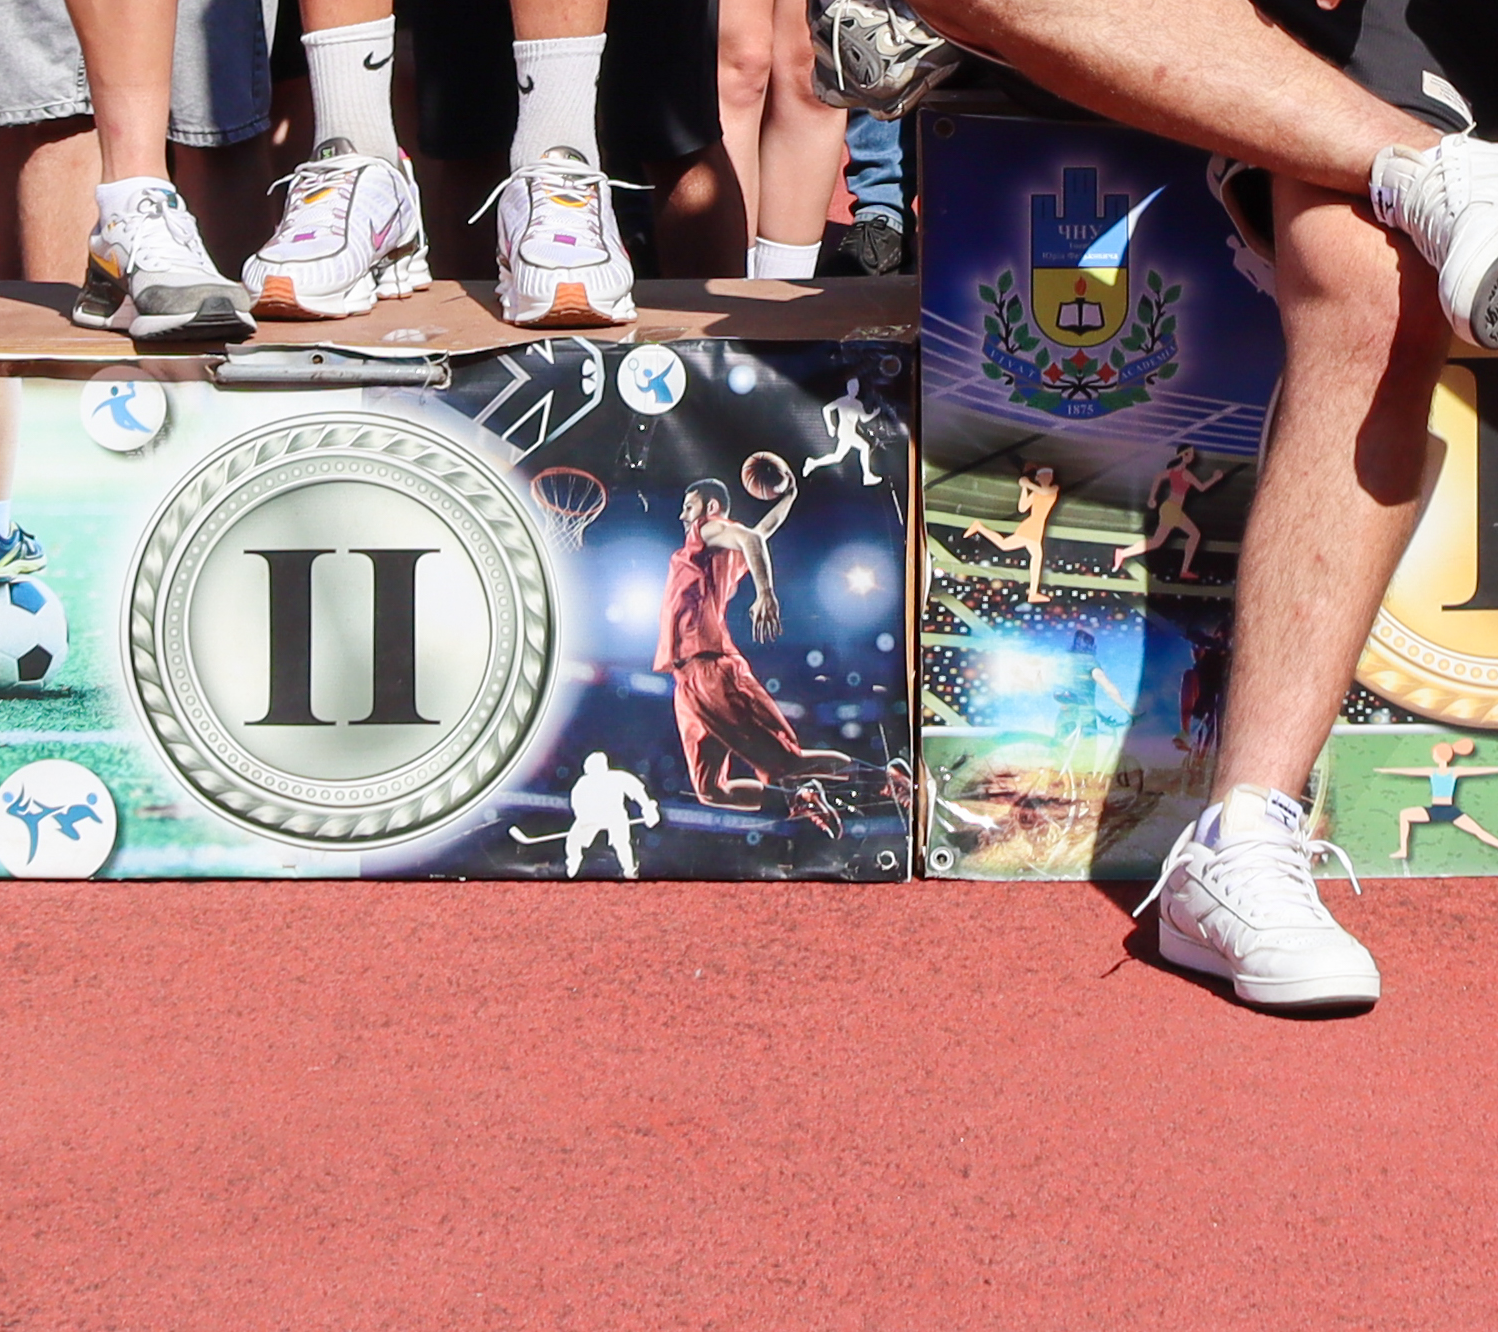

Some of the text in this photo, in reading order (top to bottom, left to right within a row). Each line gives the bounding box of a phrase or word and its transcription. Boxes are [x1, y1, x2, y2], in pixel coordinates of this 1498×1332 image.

[989, 344, 1177, 381] VIVAT ACADEMIA
[1066, 403, 1094, 416] 1875
[242, 548, 441, 727] II
